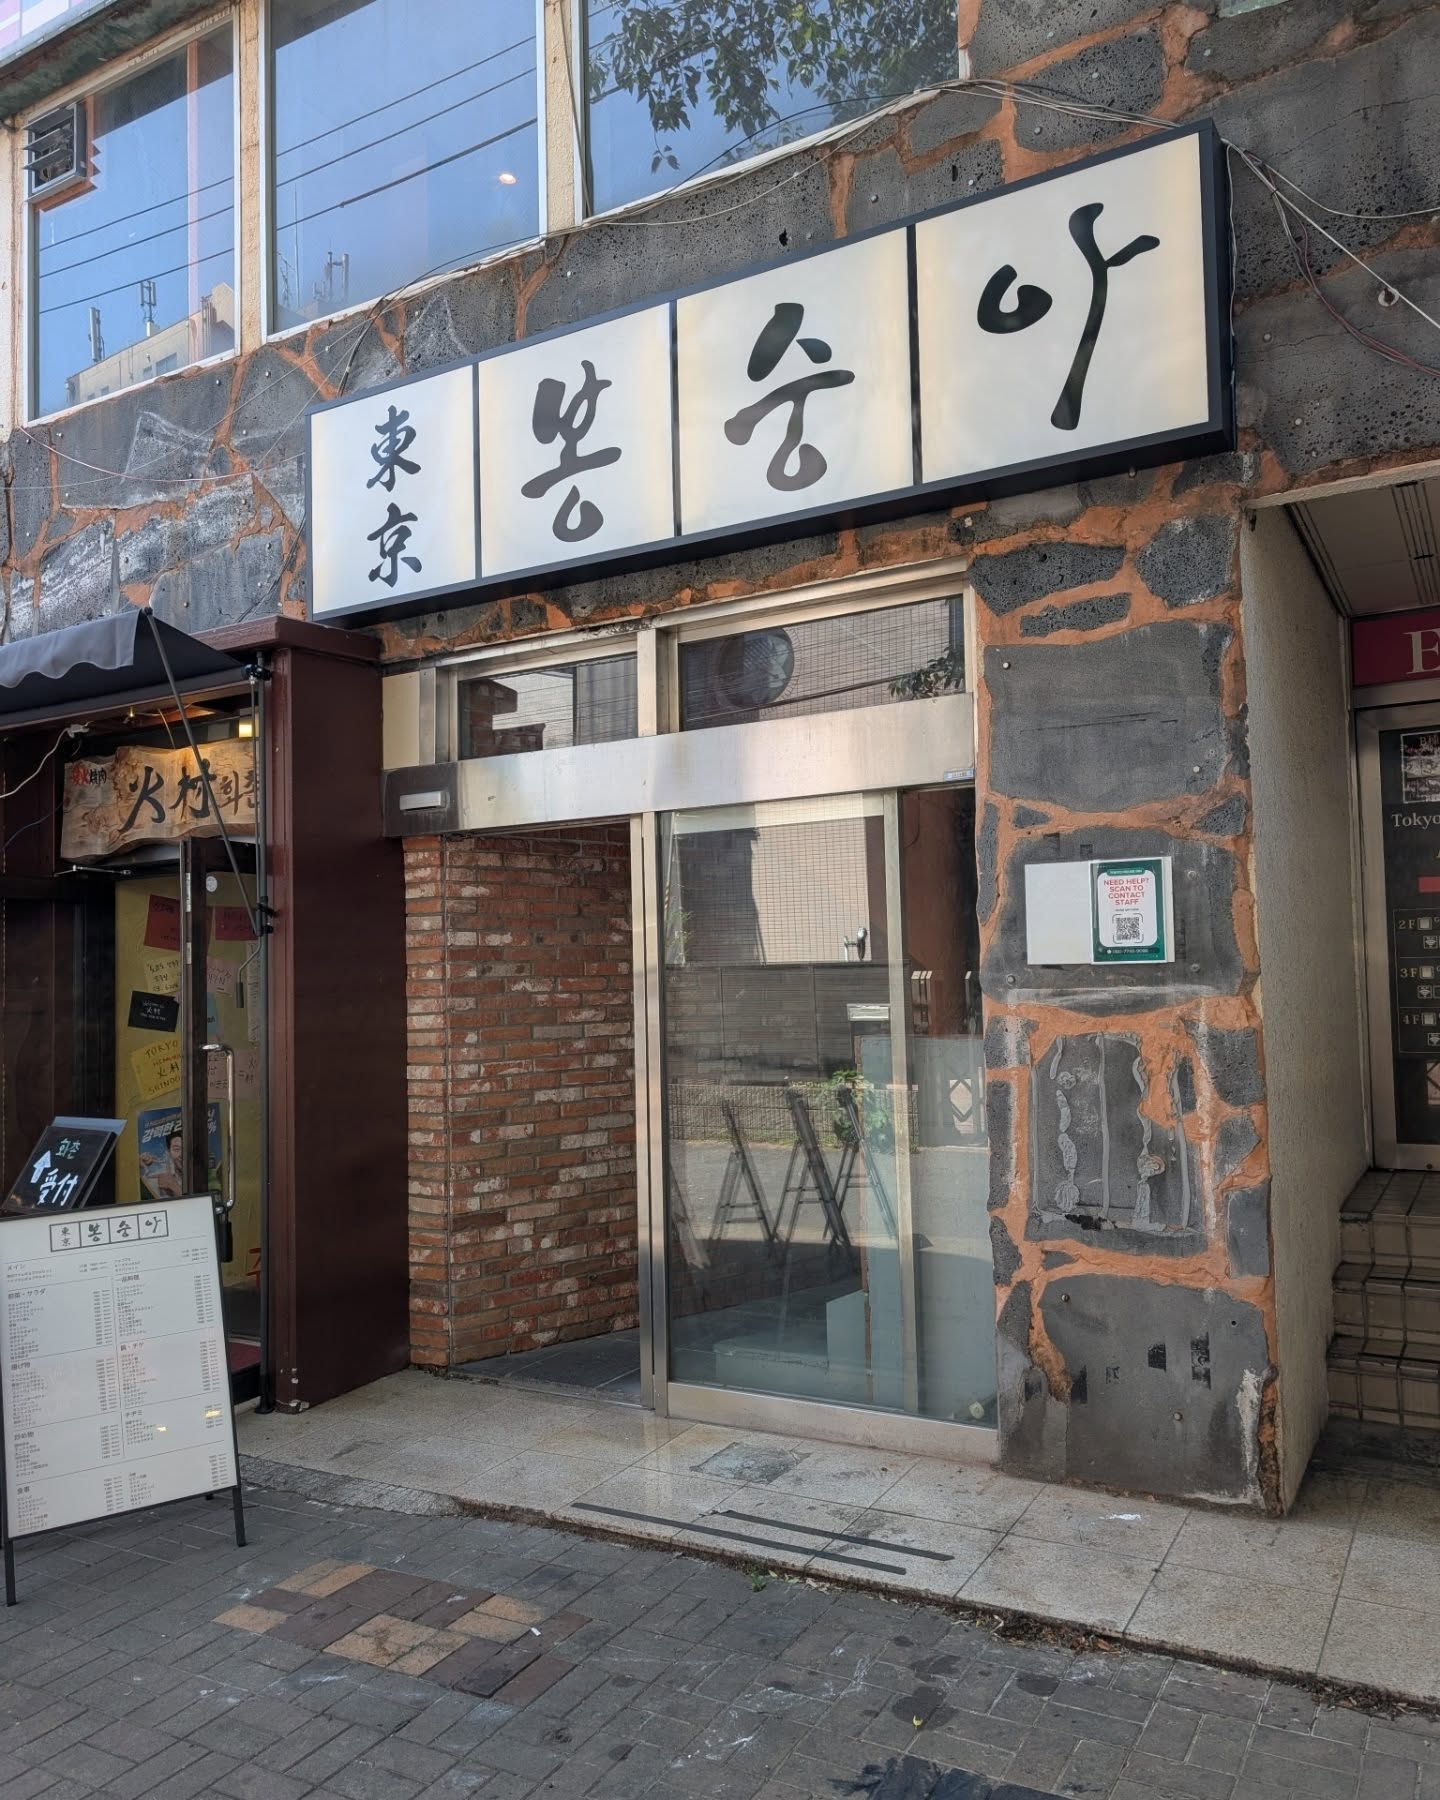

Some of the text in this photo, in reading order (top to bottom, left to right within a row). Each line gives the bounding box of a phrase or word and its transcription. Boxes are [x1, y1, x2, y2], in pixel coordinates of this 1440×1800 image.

[520, 202, 1161, 544] 봉숭아
[366, 405, 423, 589] 東京
[1392, 812, 1440, 830] Tokyo
[1103, 877, 1150, 886] NEED HELP?
[1109, 885, 1131, 893] SCAN
[1108, 891, 1145, 899] CONTACT
[1114, 898, 1139, 906] STAFF
[145, 1040, 179, 1058] TOKYO
[56, 1138, 81, 1160] 화촌
[37, 1168, 78, 1206] 受付
[61, 1227, 71, 1246] 東京
[87, 1216, 162, 1243] 봉숭아
